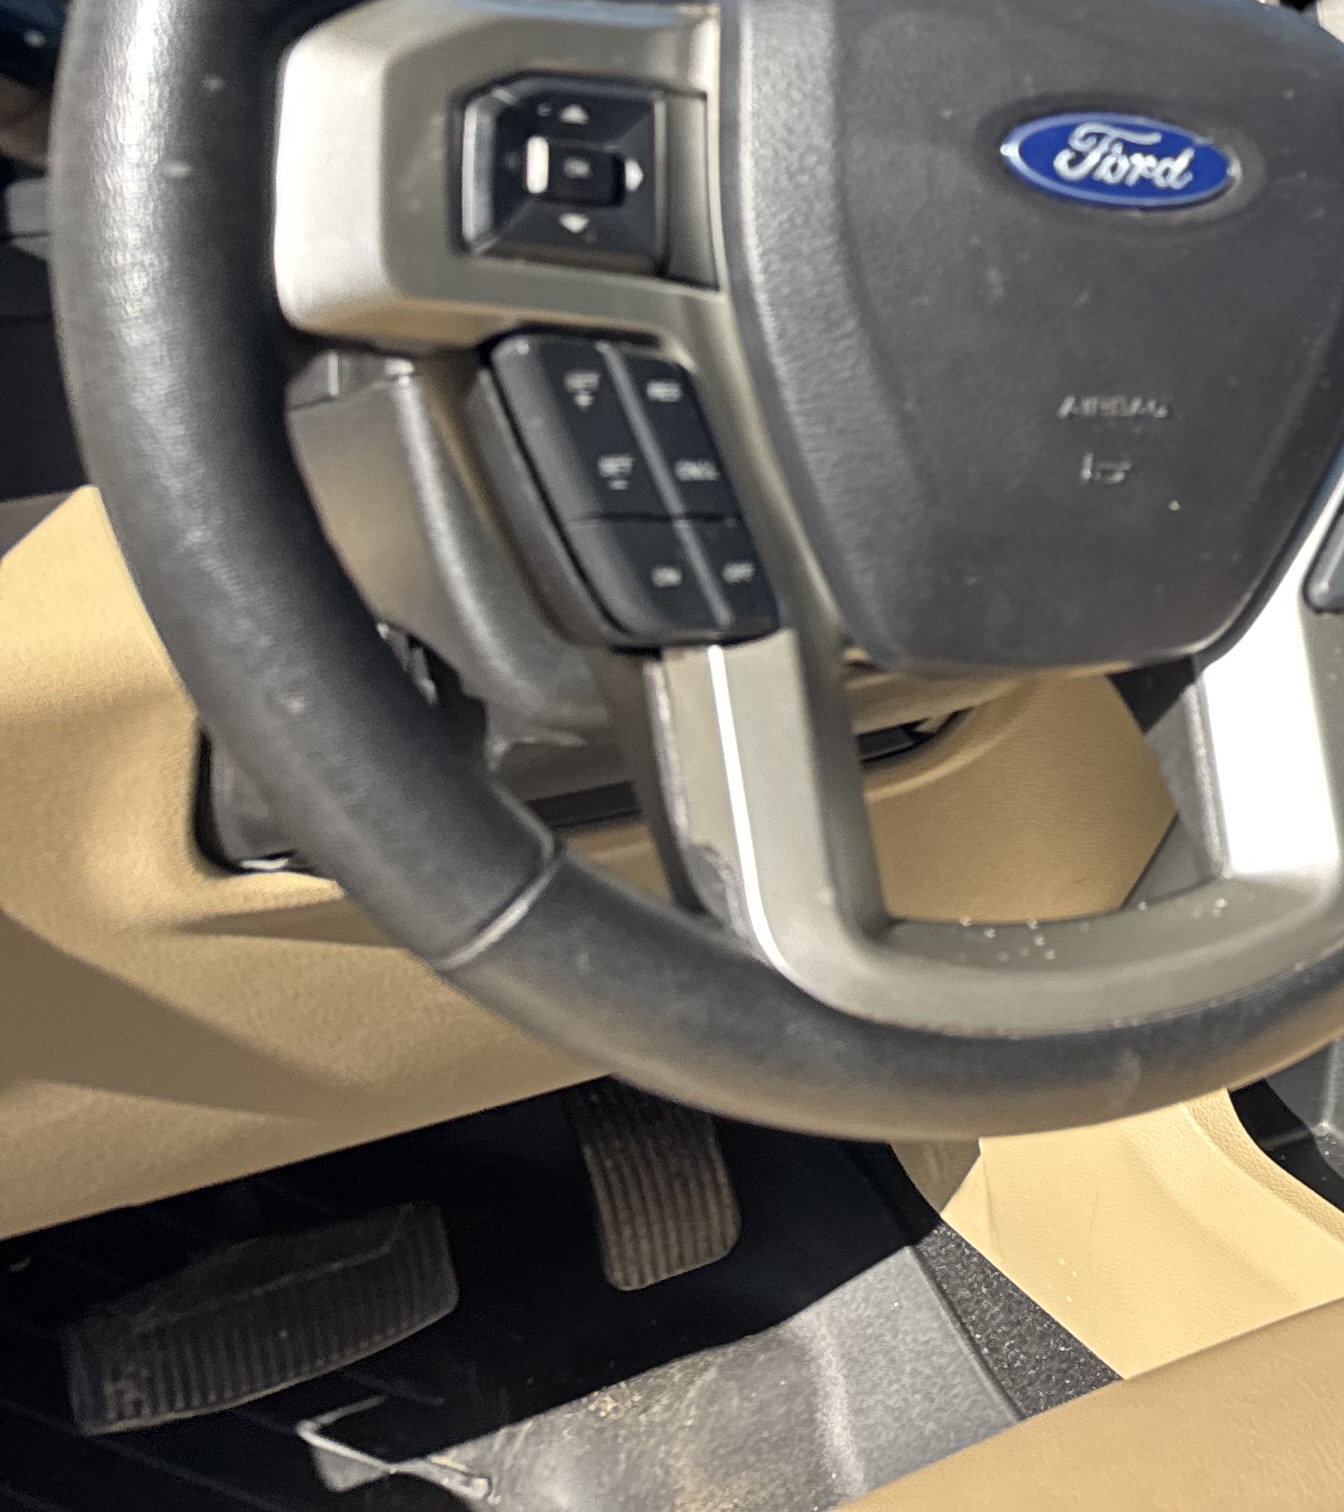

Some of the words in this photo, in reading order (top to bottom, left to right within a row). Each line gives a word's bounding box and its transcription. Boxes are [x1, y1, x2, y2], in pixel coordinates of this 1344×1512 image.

[1053, 121, 1195, 190] Ford
[1057, 395, 1169, 419] AIRBAG
[653, 566, 683, 587] ON
[722, 563, 755, 583] OFF
